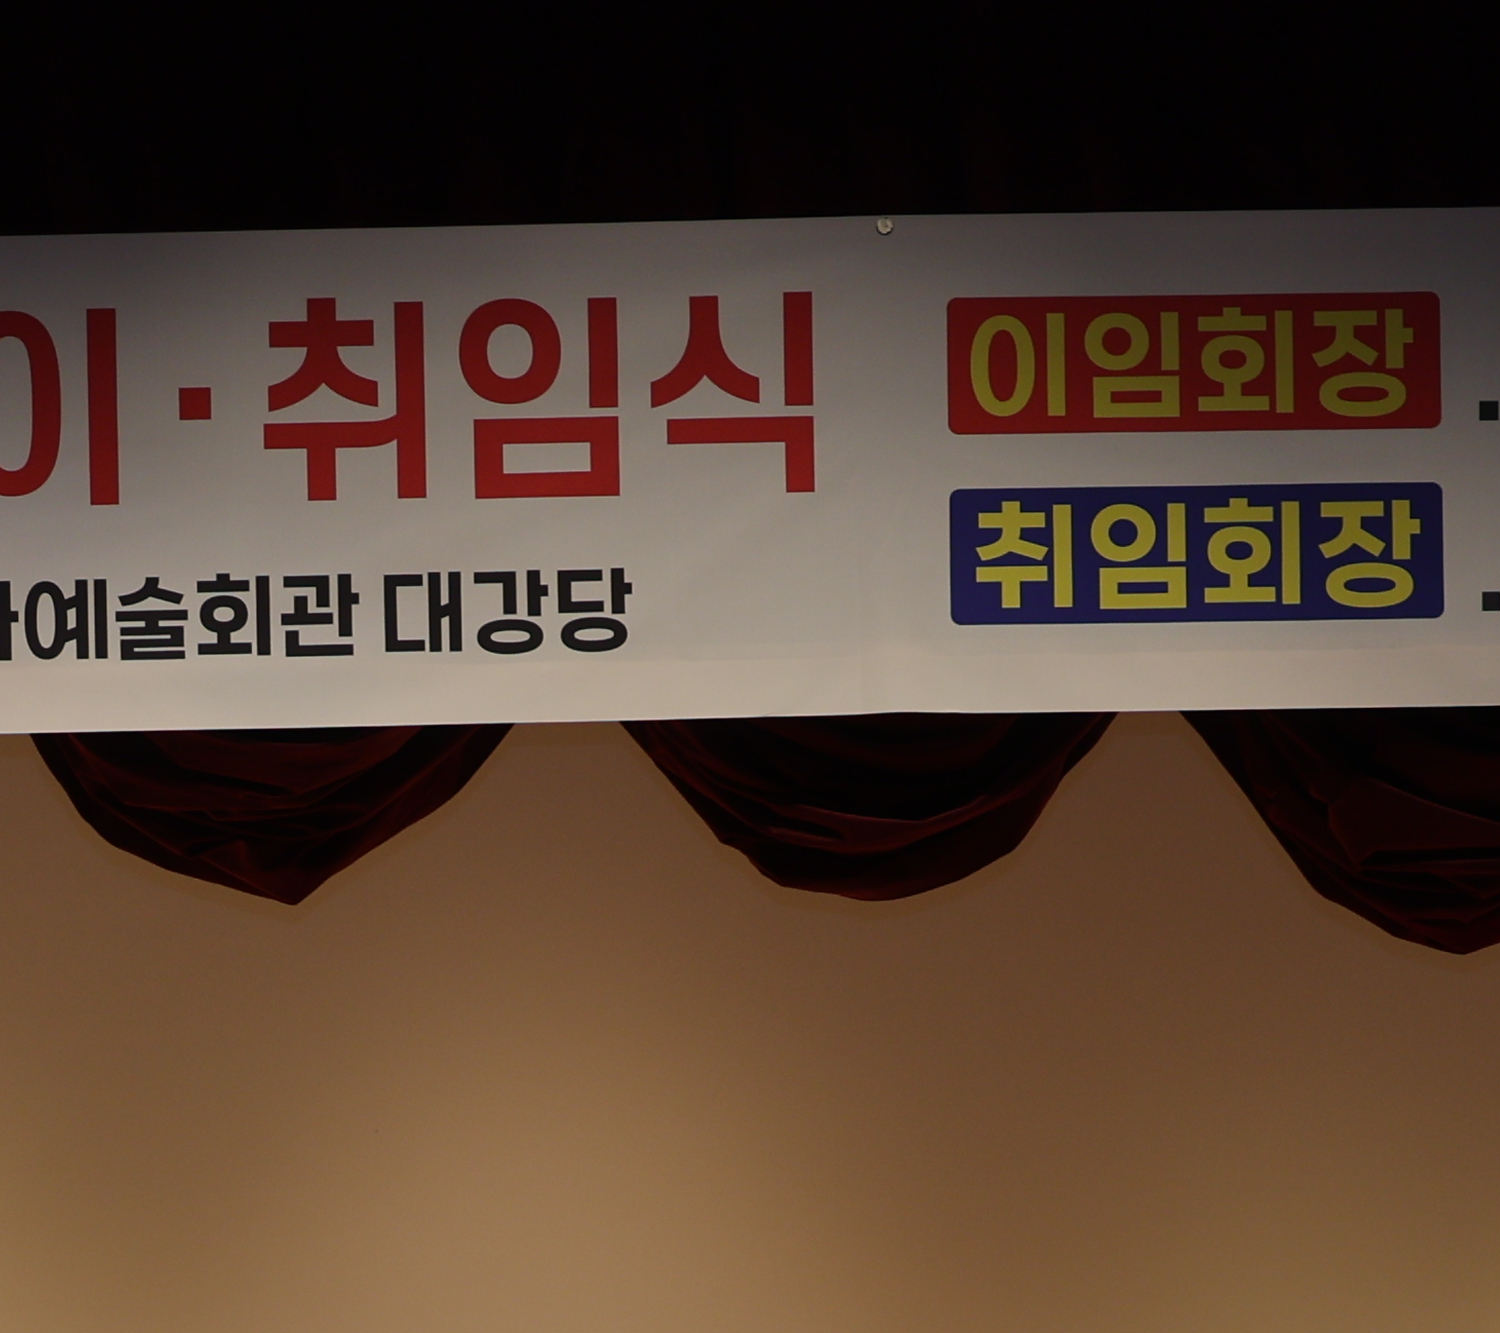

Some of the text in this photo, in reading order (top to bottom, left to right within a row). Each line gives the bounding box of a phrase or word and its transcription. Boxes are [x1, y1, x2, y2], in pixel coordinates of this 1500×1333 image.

[969, 306, 1415, 419] 이임회장
[975, 497, 1422, 610] 취임회장
[383, 570, 633, 655] 대강당
